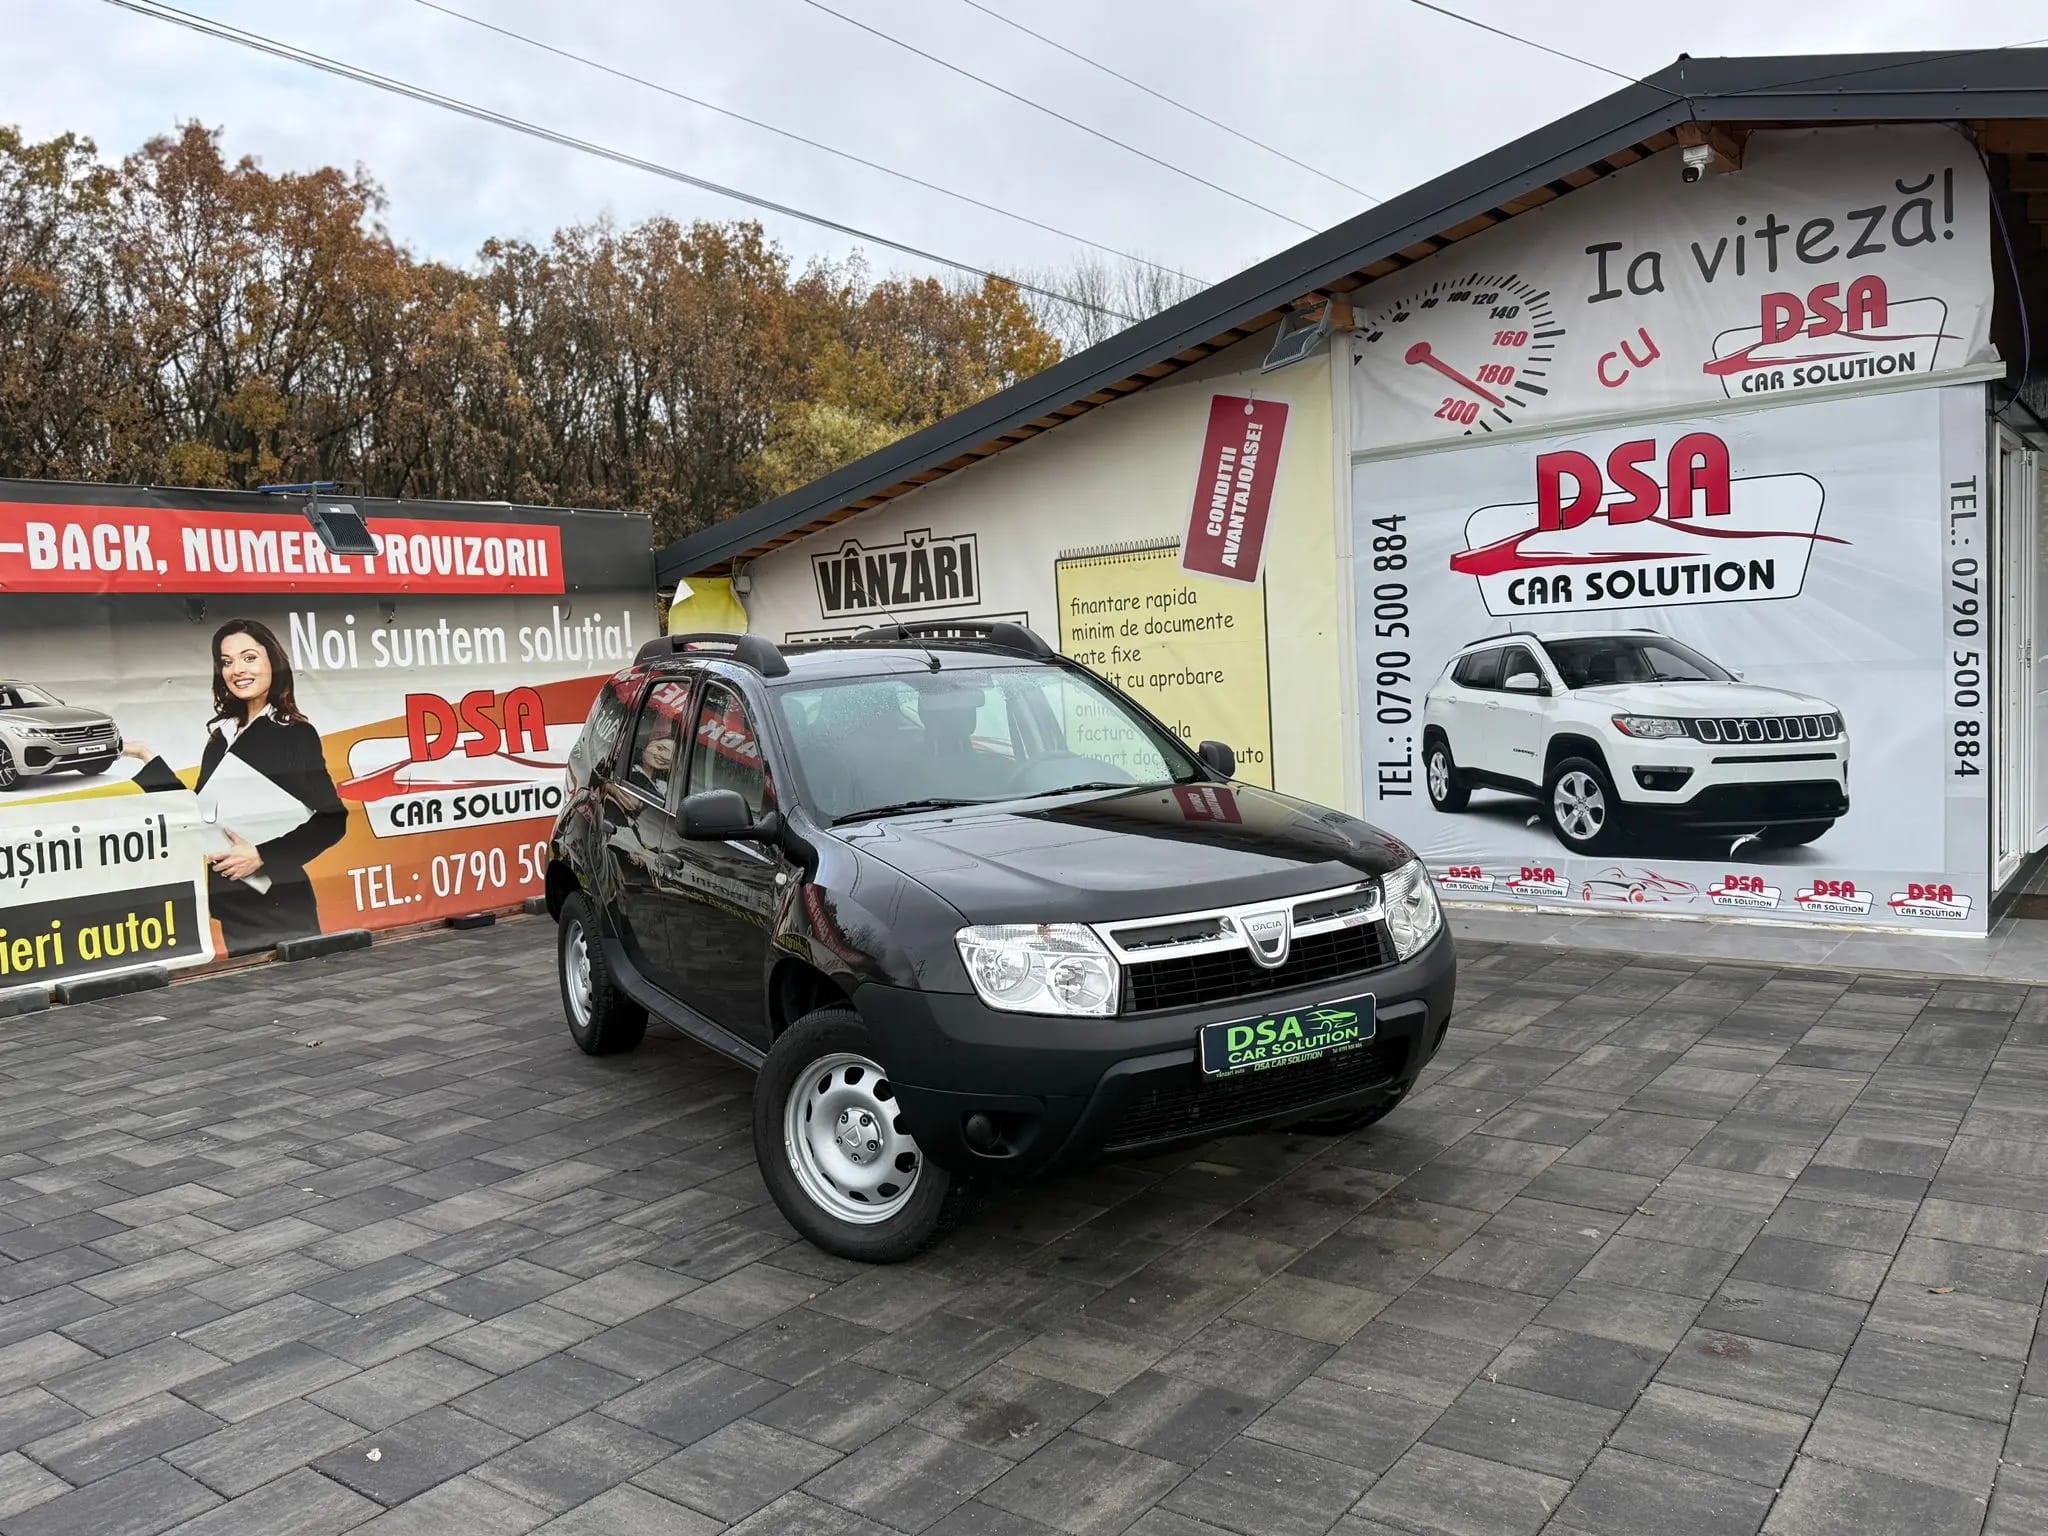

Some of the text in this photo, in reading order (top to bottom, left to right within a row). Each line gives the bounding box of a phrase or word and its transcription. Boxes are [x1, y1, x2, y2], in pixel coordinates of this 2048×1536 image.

[1585, 167, 1954, 304] Ia viteză!
[1472, 293, 1499, 305] 120
[1488, 306, 1520, 320] 140
[1761, 274, 1888, 346] DSA
[1492, 330, 1529, 347] 160
[1475, 363, 1516, 386] 180
[1598, 327, 1661, 388] cu
[1741, 351, 1916, 393] CAR SOLUTION
[1433, 397, 1480, 425] 200
[1206, 446, 1238, 537] CONDITII
[1221, 422, 1264, 568] AVANTAJOASE!
[1536, 432, 1731, 532] DSA
[1372, 514, 1408, 571] 884
[819, 536, 974, 611] VÂNZĂRI
[1507, 559, 1775, 606] CAR SOLUTION
[1070, 586, 1197, 616] finantare rapida
[1373, 583, 1410, 637] 500
[1951, 558, 1979, 637] 0790
[289, 611, 358, 671] Noi
[371, 618, 507, 669] suntem
[1072, 612, 1234, 641] minim de documente
[1074, 645, 1142, 665] rate fixe
[1127, 674, 1144, 688] cu
[1149, 667, 1225, 692] aprobare
[1375, 651, 1412, 724] 0790
[1953, 650, 1980, 707] 500
[405, 686, 549, 762] DSA
[1236, 747, 1264, 764] uto
[1954, 720, 1980, 778] 884
[389, 786, 563, 828] CAR SOLUTIO
[99, 814, 169, 866] noi!
[347, 841, 551, 912] TEL.: 0790 50
[1449, 866, 1482, 880] DSA
[1459, 883, 1489, 892] SOLUTION
[1516, 887, 1563, 896] CAR SOLUTION
[1520, 866, 1555, 883] DSA
[1724, 874, 1764, 893] DSA
[1813, 879, 1856, 898] DSA
[1718, 897, 1772, 908] CAR SOLUTION
[1807, 903, 1864, 913] CAR SOLUTION
[1908, 883, 1953, 902] DSA
[78, 900, 177, 961] auto!
[1252, 920, 1283, 932] DACIA
[1901, 907, 1962, 918] CAR SOLUTION
[1227, 1015, 1304, 1052] DSA
[1228, 1047, 1266, 1064] CAR
[1271, 1026, 1359, 1055] SOLUTION
[1254, 1050, 1323, 1071] DSA CAR SOLUTION
